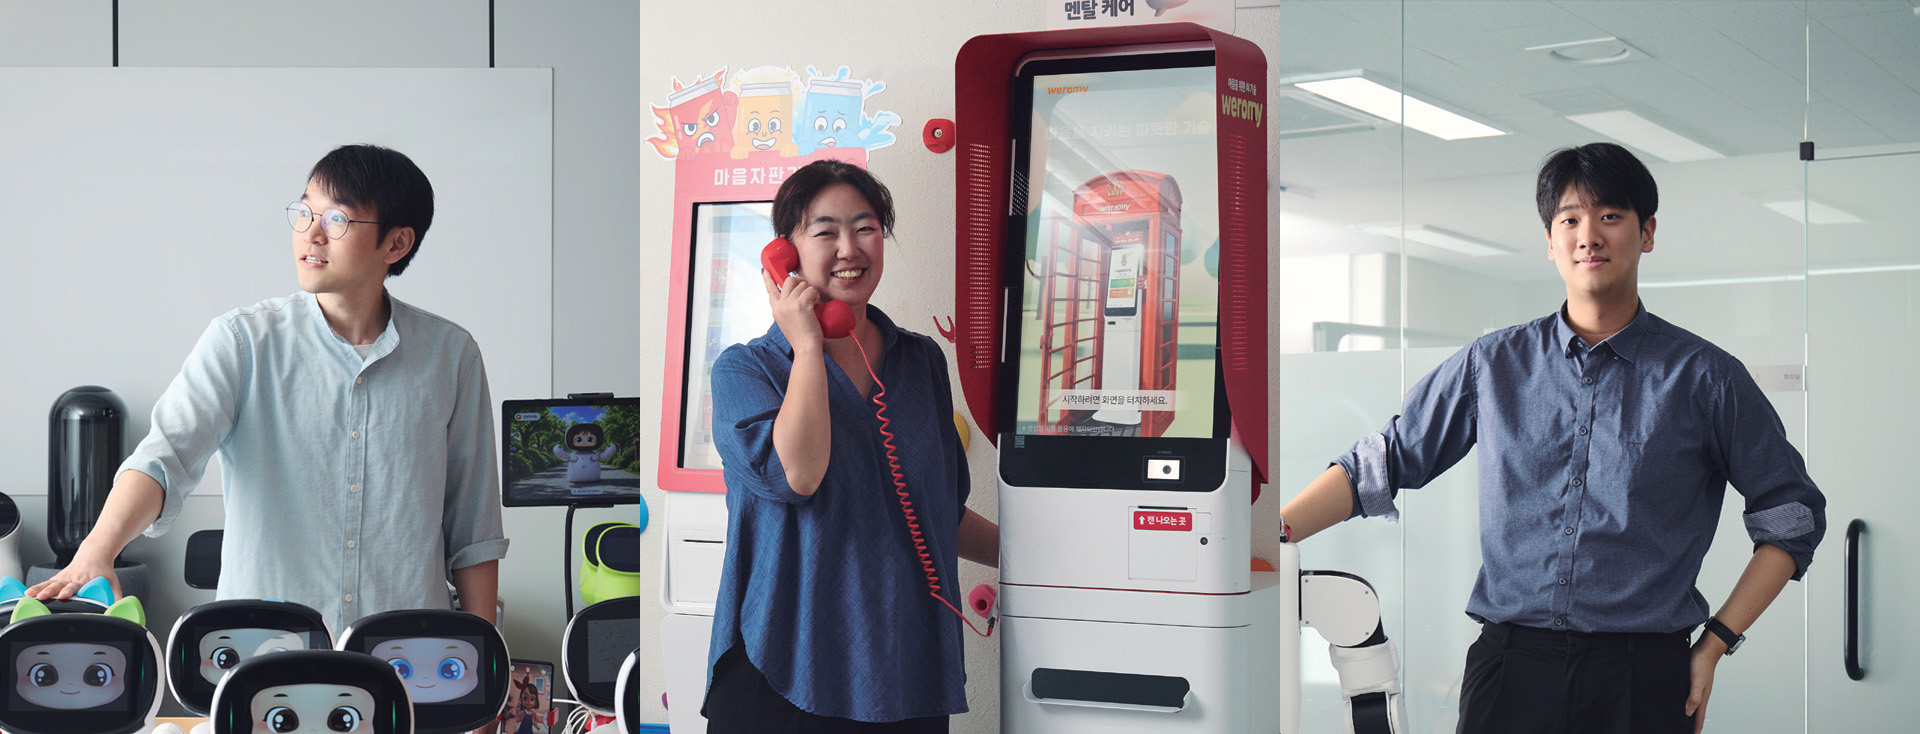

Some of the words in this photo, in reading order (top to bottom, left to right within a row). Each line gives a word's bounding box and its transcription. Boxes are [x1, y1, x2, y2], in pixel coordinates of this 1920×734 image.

[1064, 0, 1098, 21] 멘탈
[1101, 0, 1135, 17] 케어
[1047, 85, 1089, 96] weromy
[1221, 94, 1263, 128] weromy
[1062, 395, 1101, 405] 시작하려면
[1102, 395, 1125, 405] 화면을
[1127, 395, 1168, 406] 터치하세요.
[1155, 516, 1178, 526] 나오는
[1178, 516, 1187, 526] 곳
